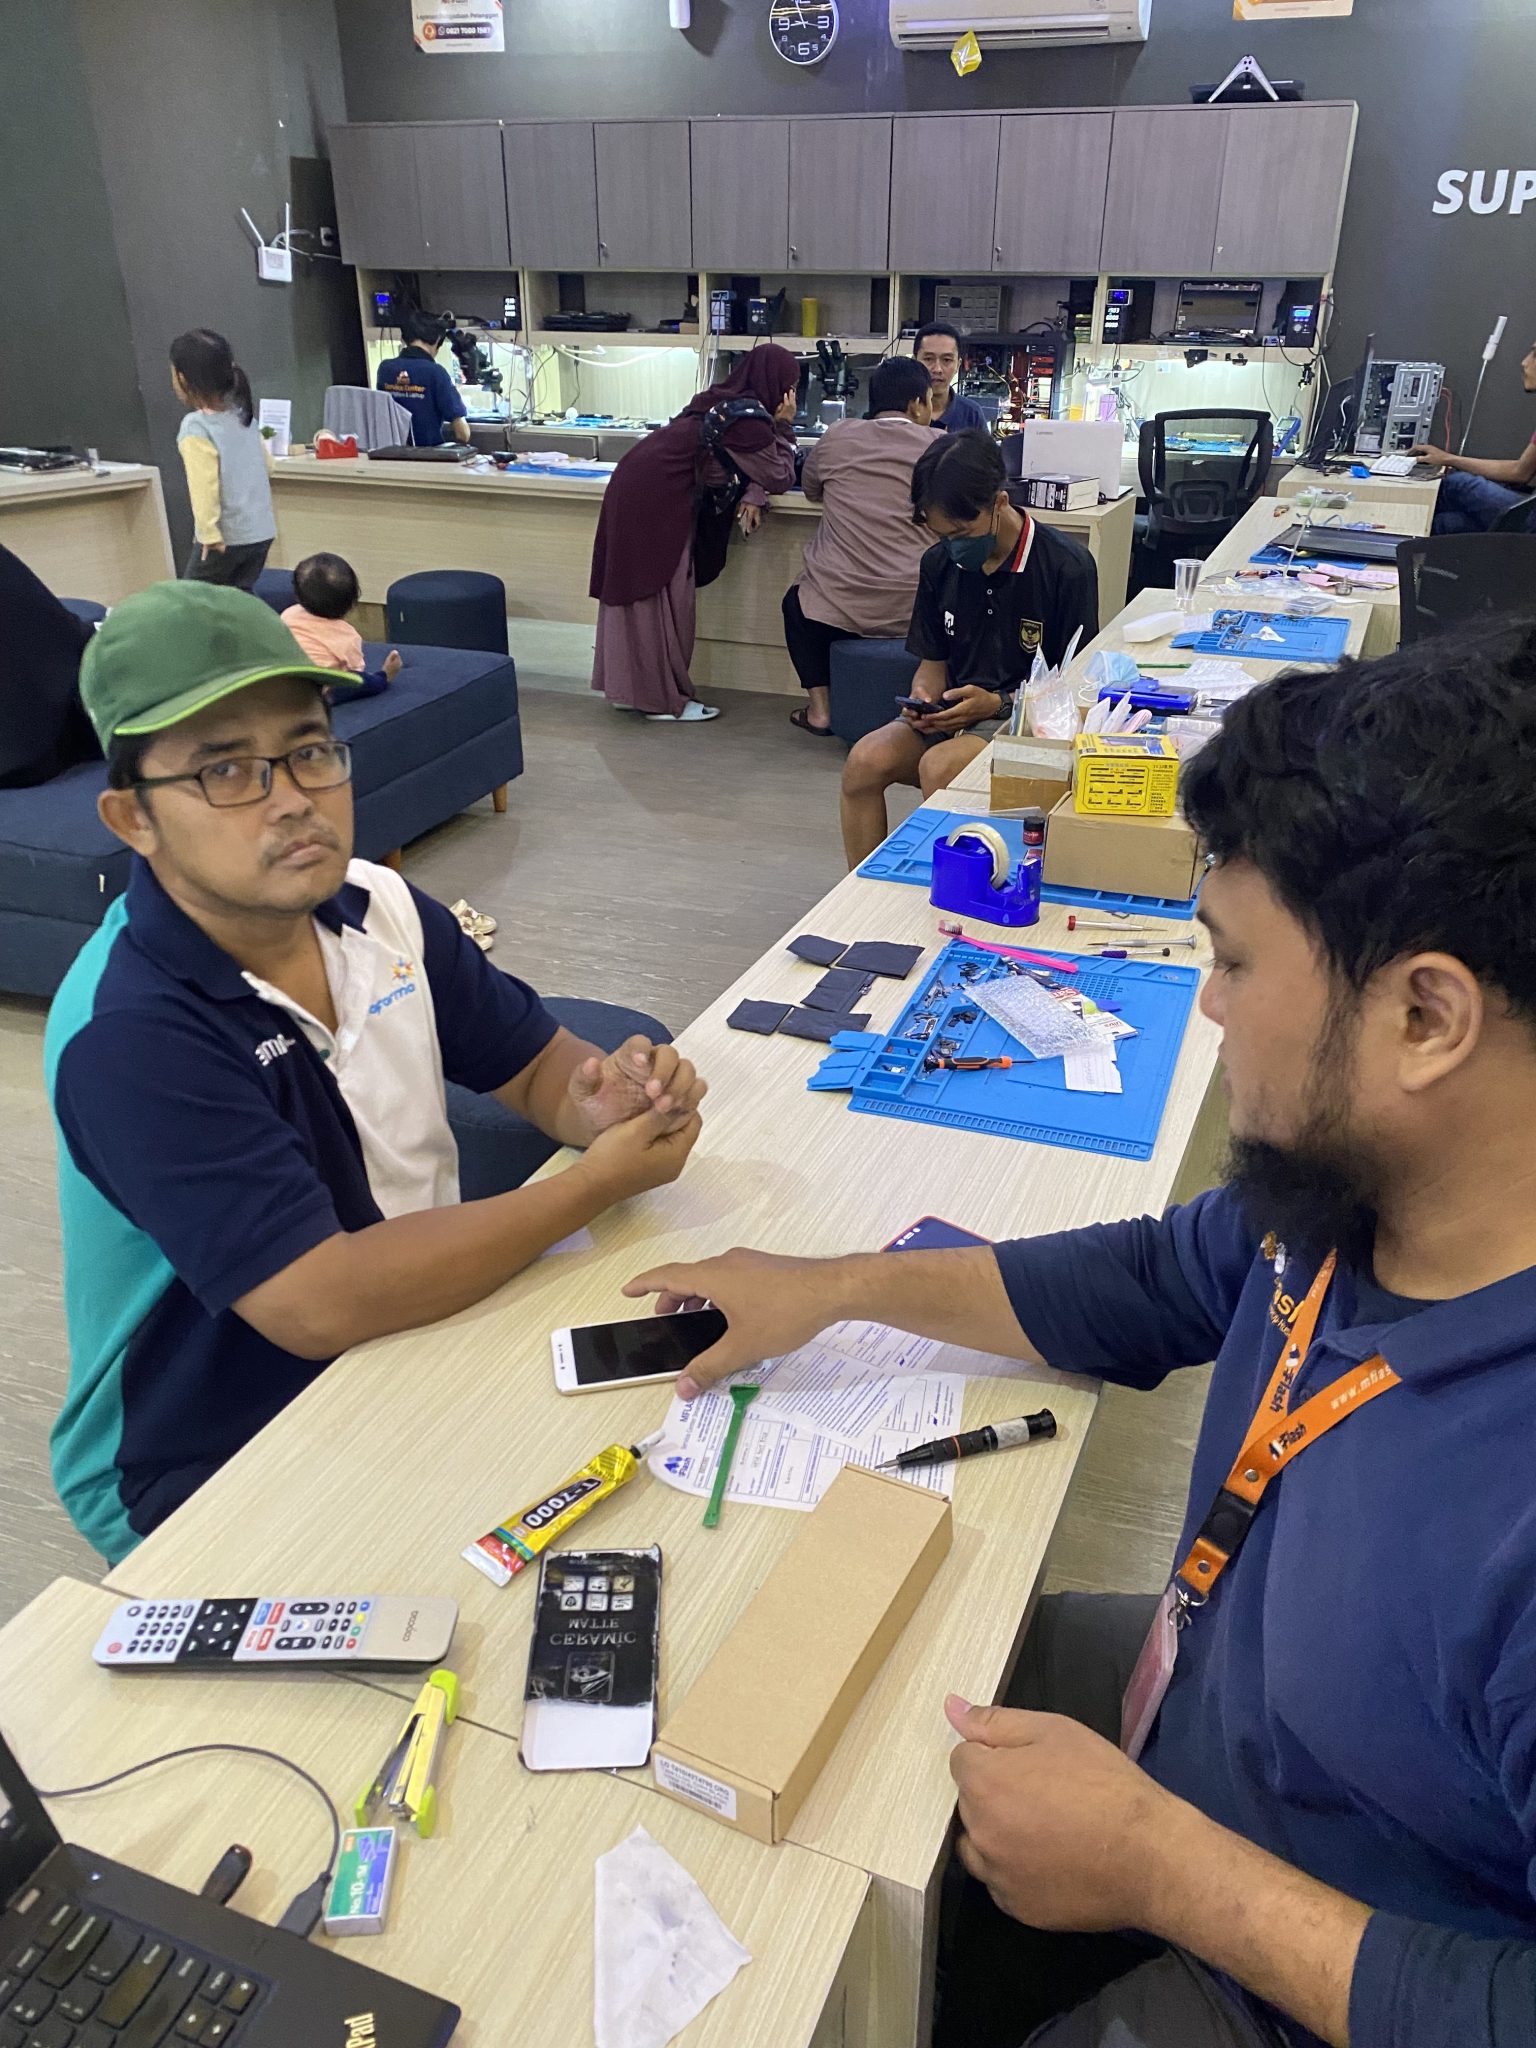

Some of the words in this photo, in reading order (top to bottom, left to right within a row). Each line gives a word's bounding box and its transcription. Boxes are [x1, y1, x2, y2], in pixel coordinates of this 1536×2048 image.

[817, 15, 830, 29] 3
[798, 42, 810, 56] 6
[525, 1480, 600, 1528] T-7000
